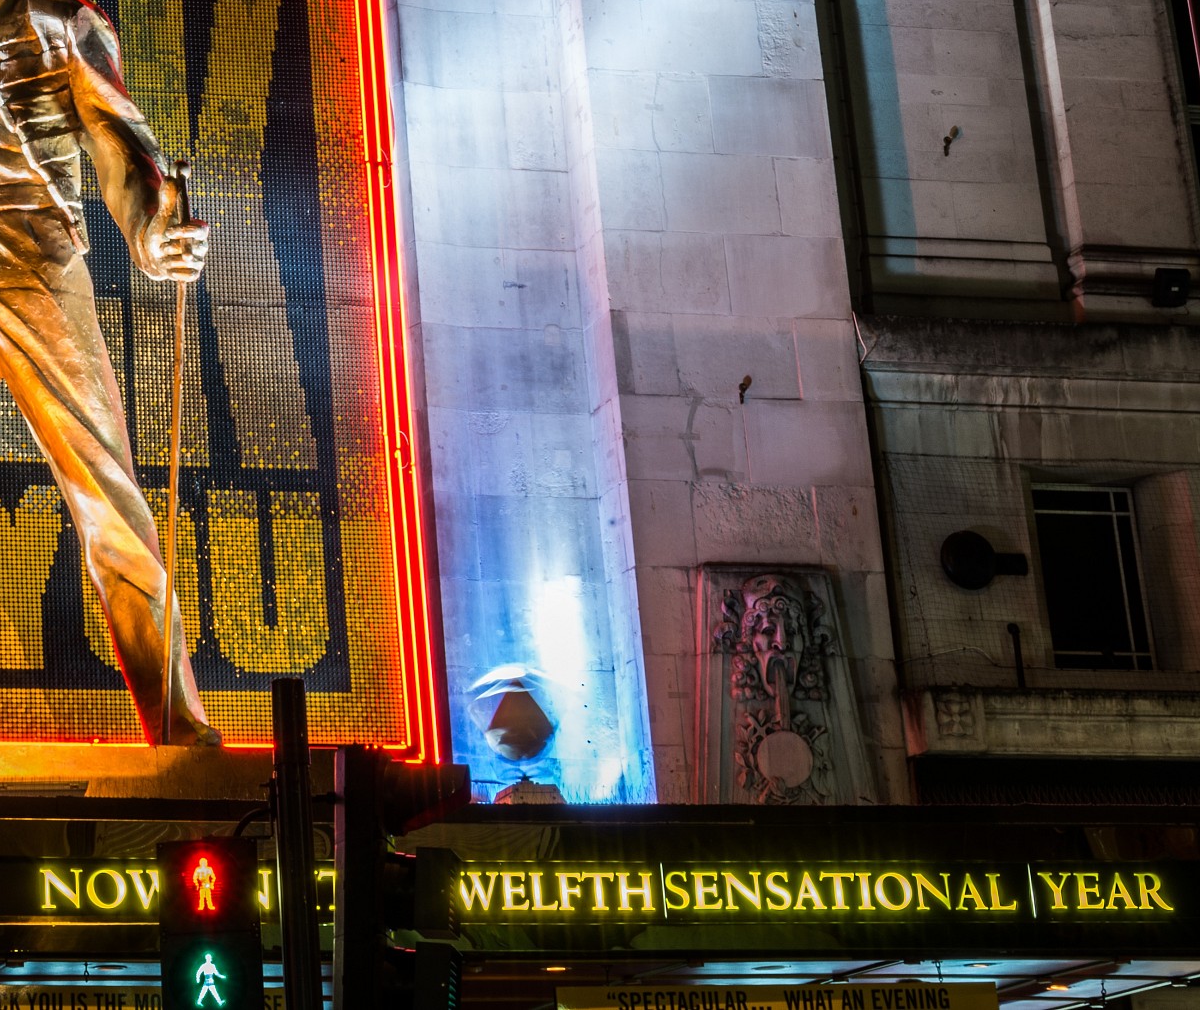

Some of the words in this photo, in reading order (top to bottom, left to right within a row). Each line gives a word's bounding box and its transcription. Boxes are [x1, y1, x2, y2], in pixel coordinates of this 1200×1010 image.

[665, 871, 1017, 911] SENSATIONAL
[1037, 872, 1174, 911] YEAR
[26, 993, 63, 1010] YOU
[70, 994, 87, 1010] IS
[93, 994, 127, 1010] THE
[784, 990, 834, 1010] WHAT
[842, 990, 863, 1010] AN
[872, 989, 950, 1010] EVENING
